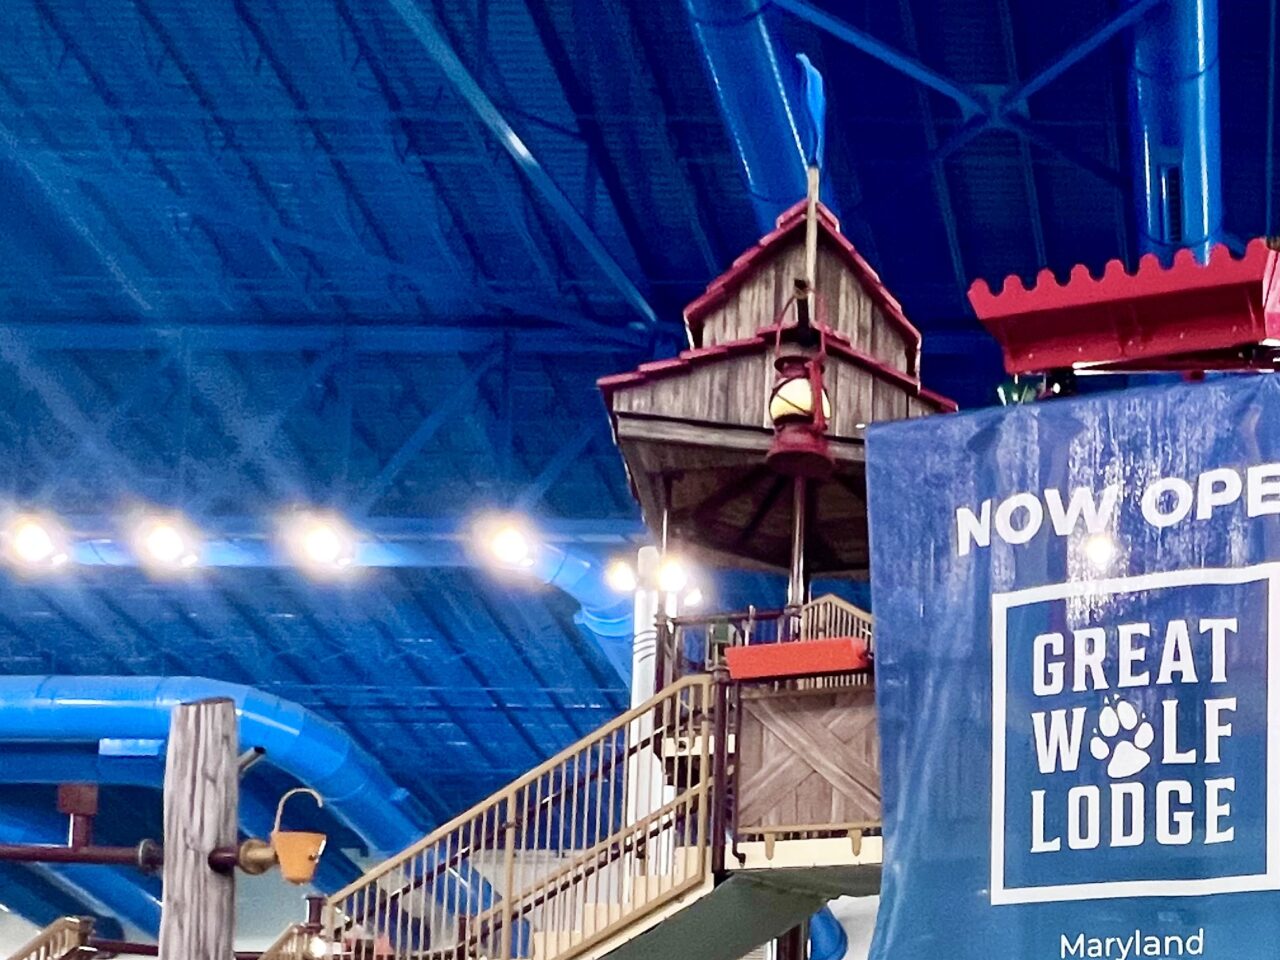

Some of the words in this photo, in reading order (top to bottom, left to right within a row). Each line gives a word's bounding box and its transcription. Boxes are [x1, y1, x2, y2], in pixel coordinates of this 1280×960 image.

[956, 485, 1117, 557] NOW
[1032, 617, 1239, 697] GREAT
[1030, 696, 1237, 779] WLF
[1029, 777, 1236, 854] LODGE
